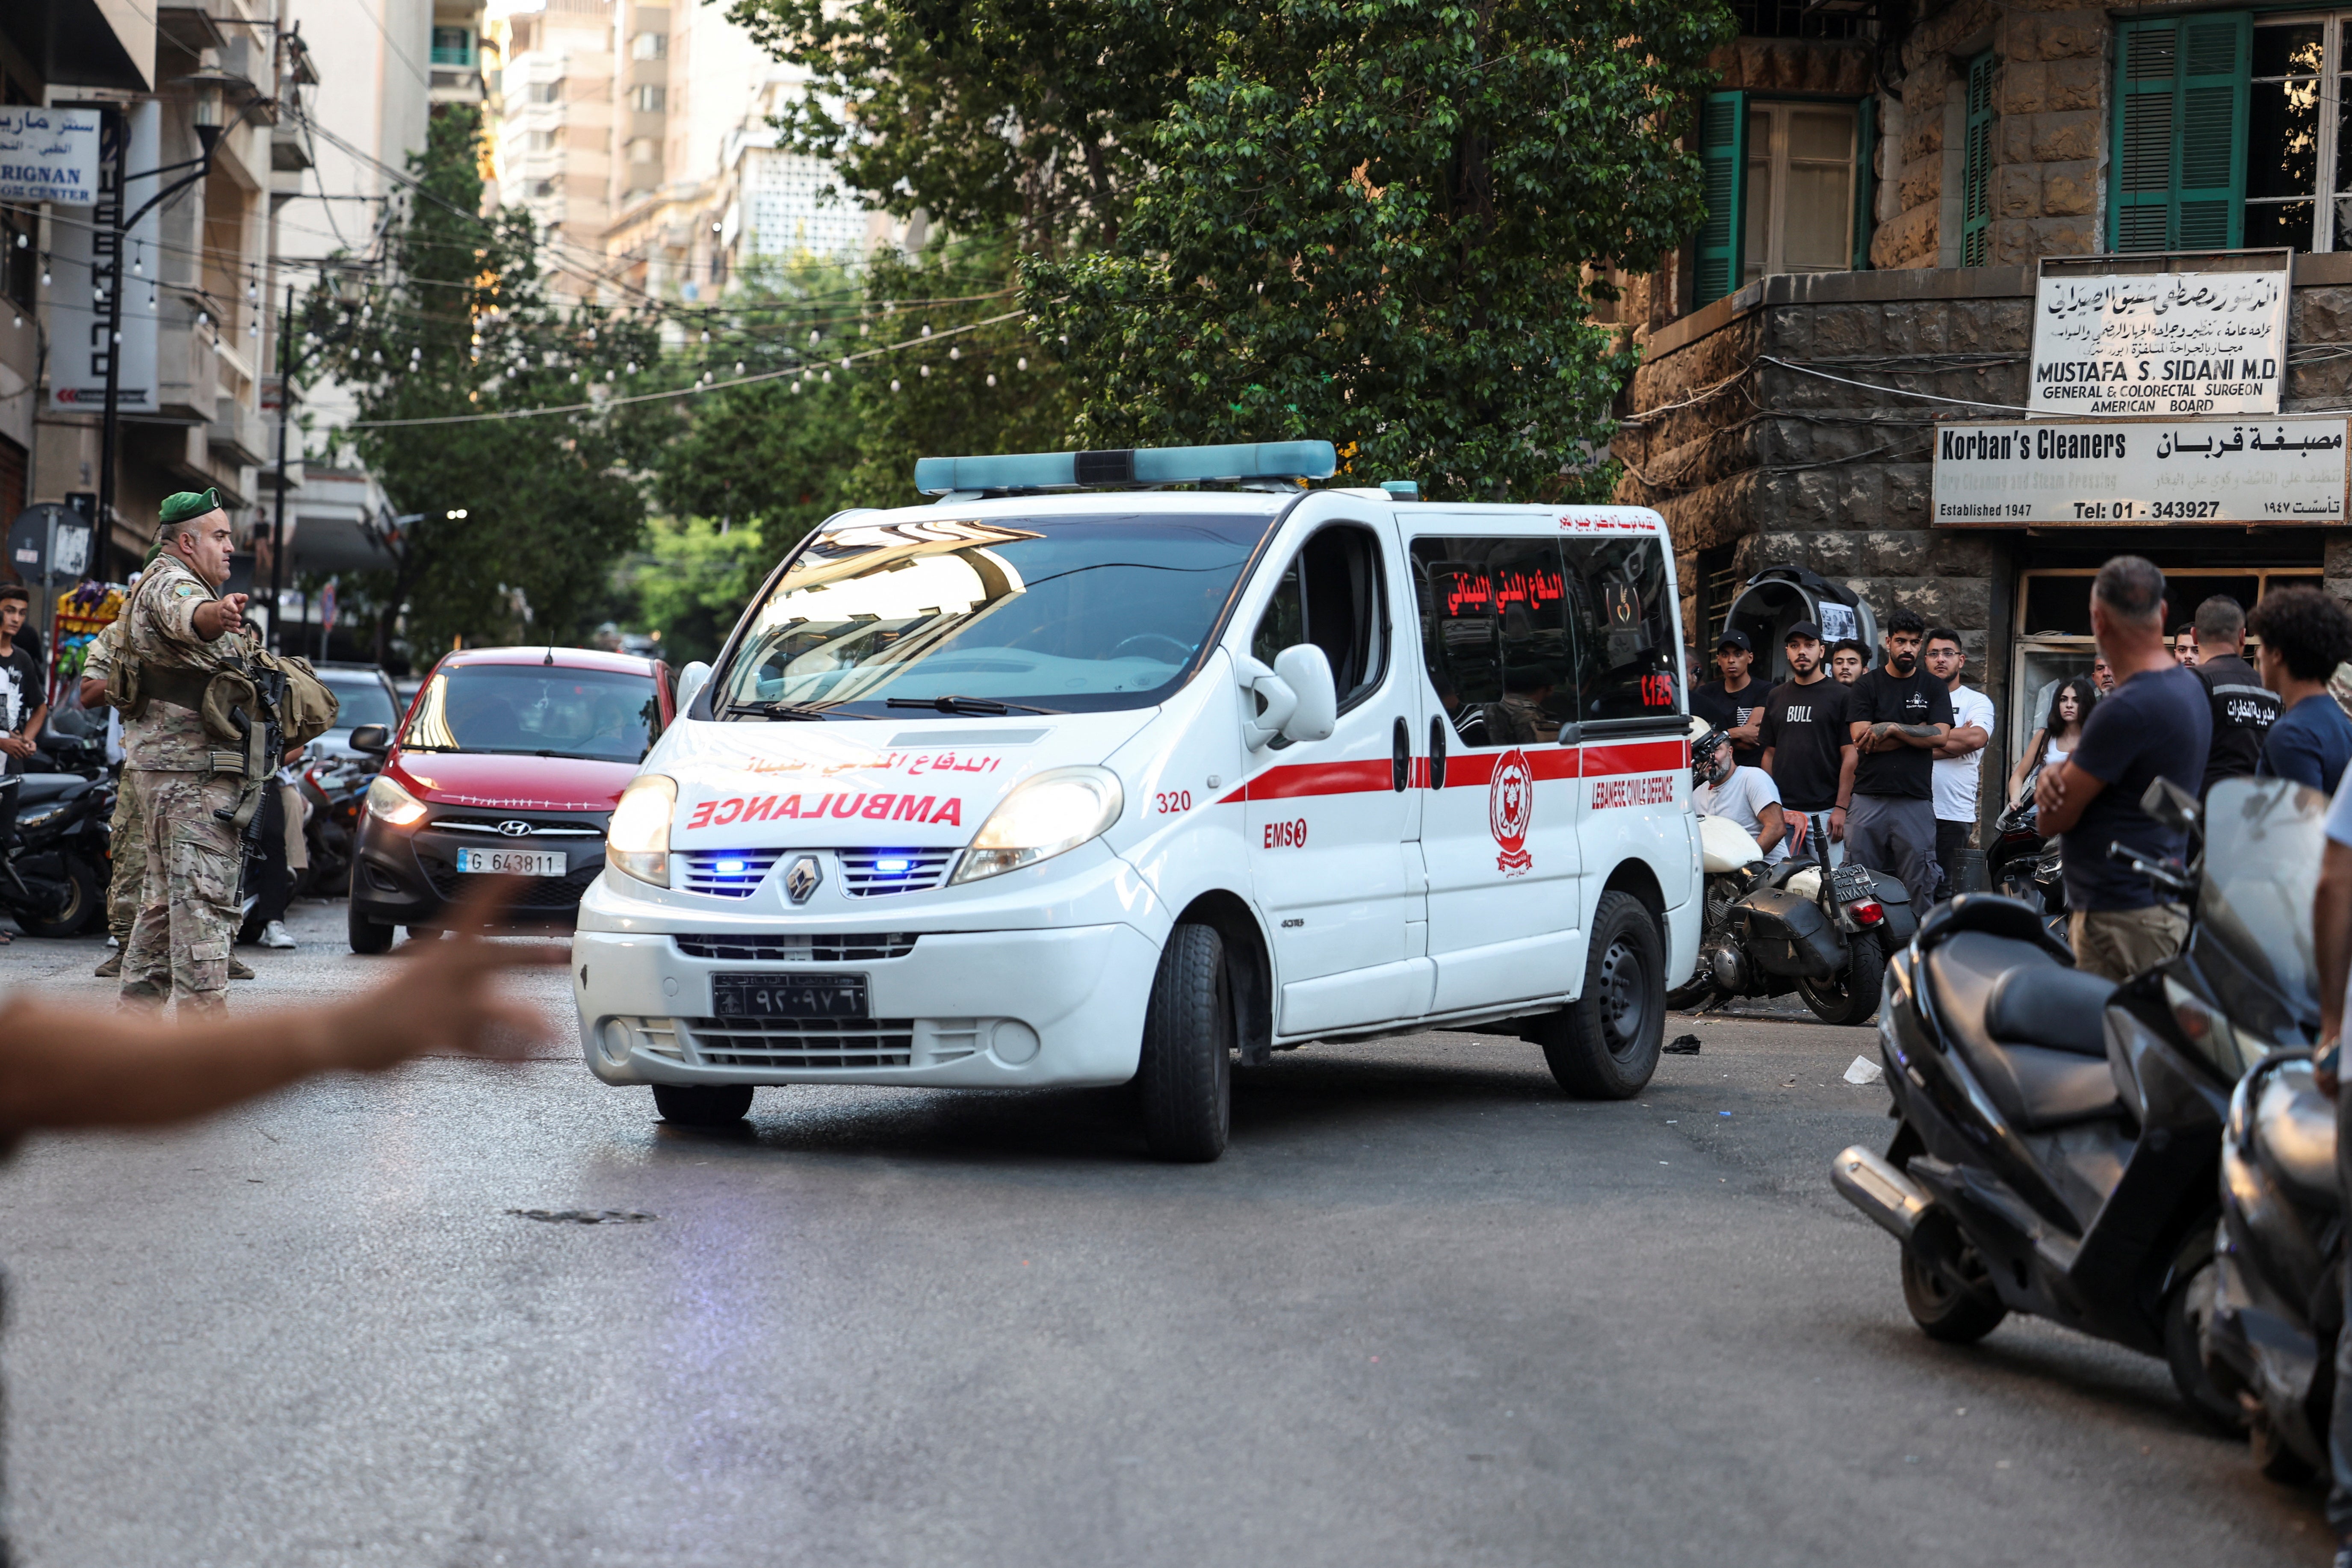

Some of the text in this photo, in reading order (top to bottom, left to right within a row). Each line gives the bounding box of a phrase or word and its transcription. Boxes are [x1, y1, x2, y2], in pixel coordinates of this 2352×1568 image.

[0, 165, 81, 184] RIGNAN
[29, 187, 89, 201] CENTER
[2036, 361, 2127, 383] MUSTAFA
[2161, 359, 2234, 381] SIDANI
[2242, 359, 2278, 380] M.D.
[2042, 383, 2263, 399] GENERAL & COLORECTAL SURGEON
[2090, 400, 2214, 413] AMERICAN BOARD
[1942, 429, 2126, 461] Korban's Cleaners
[2157, 426, 2342, 459] مصبغة قربان
[2011, 471, 2028, 490] and
[2033, 471, 2064, 490] Steam
[2068, 471, 2116, 491] Pressing
[1940, 503, 2031, 517] Established 1947
[2074, 502, 2105, 519] Tel:
[2113, 502, 2133, 519] 01
[2152, 501, 2220, 518] 343927
[2264, 502, 2290, 514] ١٩٤٧
[1448, 568, 1564, 616] الدفاع المدني اللبناني
[1787, 706, 1812, 722] BULL
[2227, 699, 2275, 726] مديرية المخابرات
[907, 751, 1002, 775] الدفاع
[1156, 790, 1191, 813] 320
[1592, 776, 1673, 809] LEBANESE CIVILE DEFENCE
[472, 853, 482, 869] G
[493, 854, 552, 873] 643811
[756, 989, 858, 1013] ٩٢٠٩٧٦
